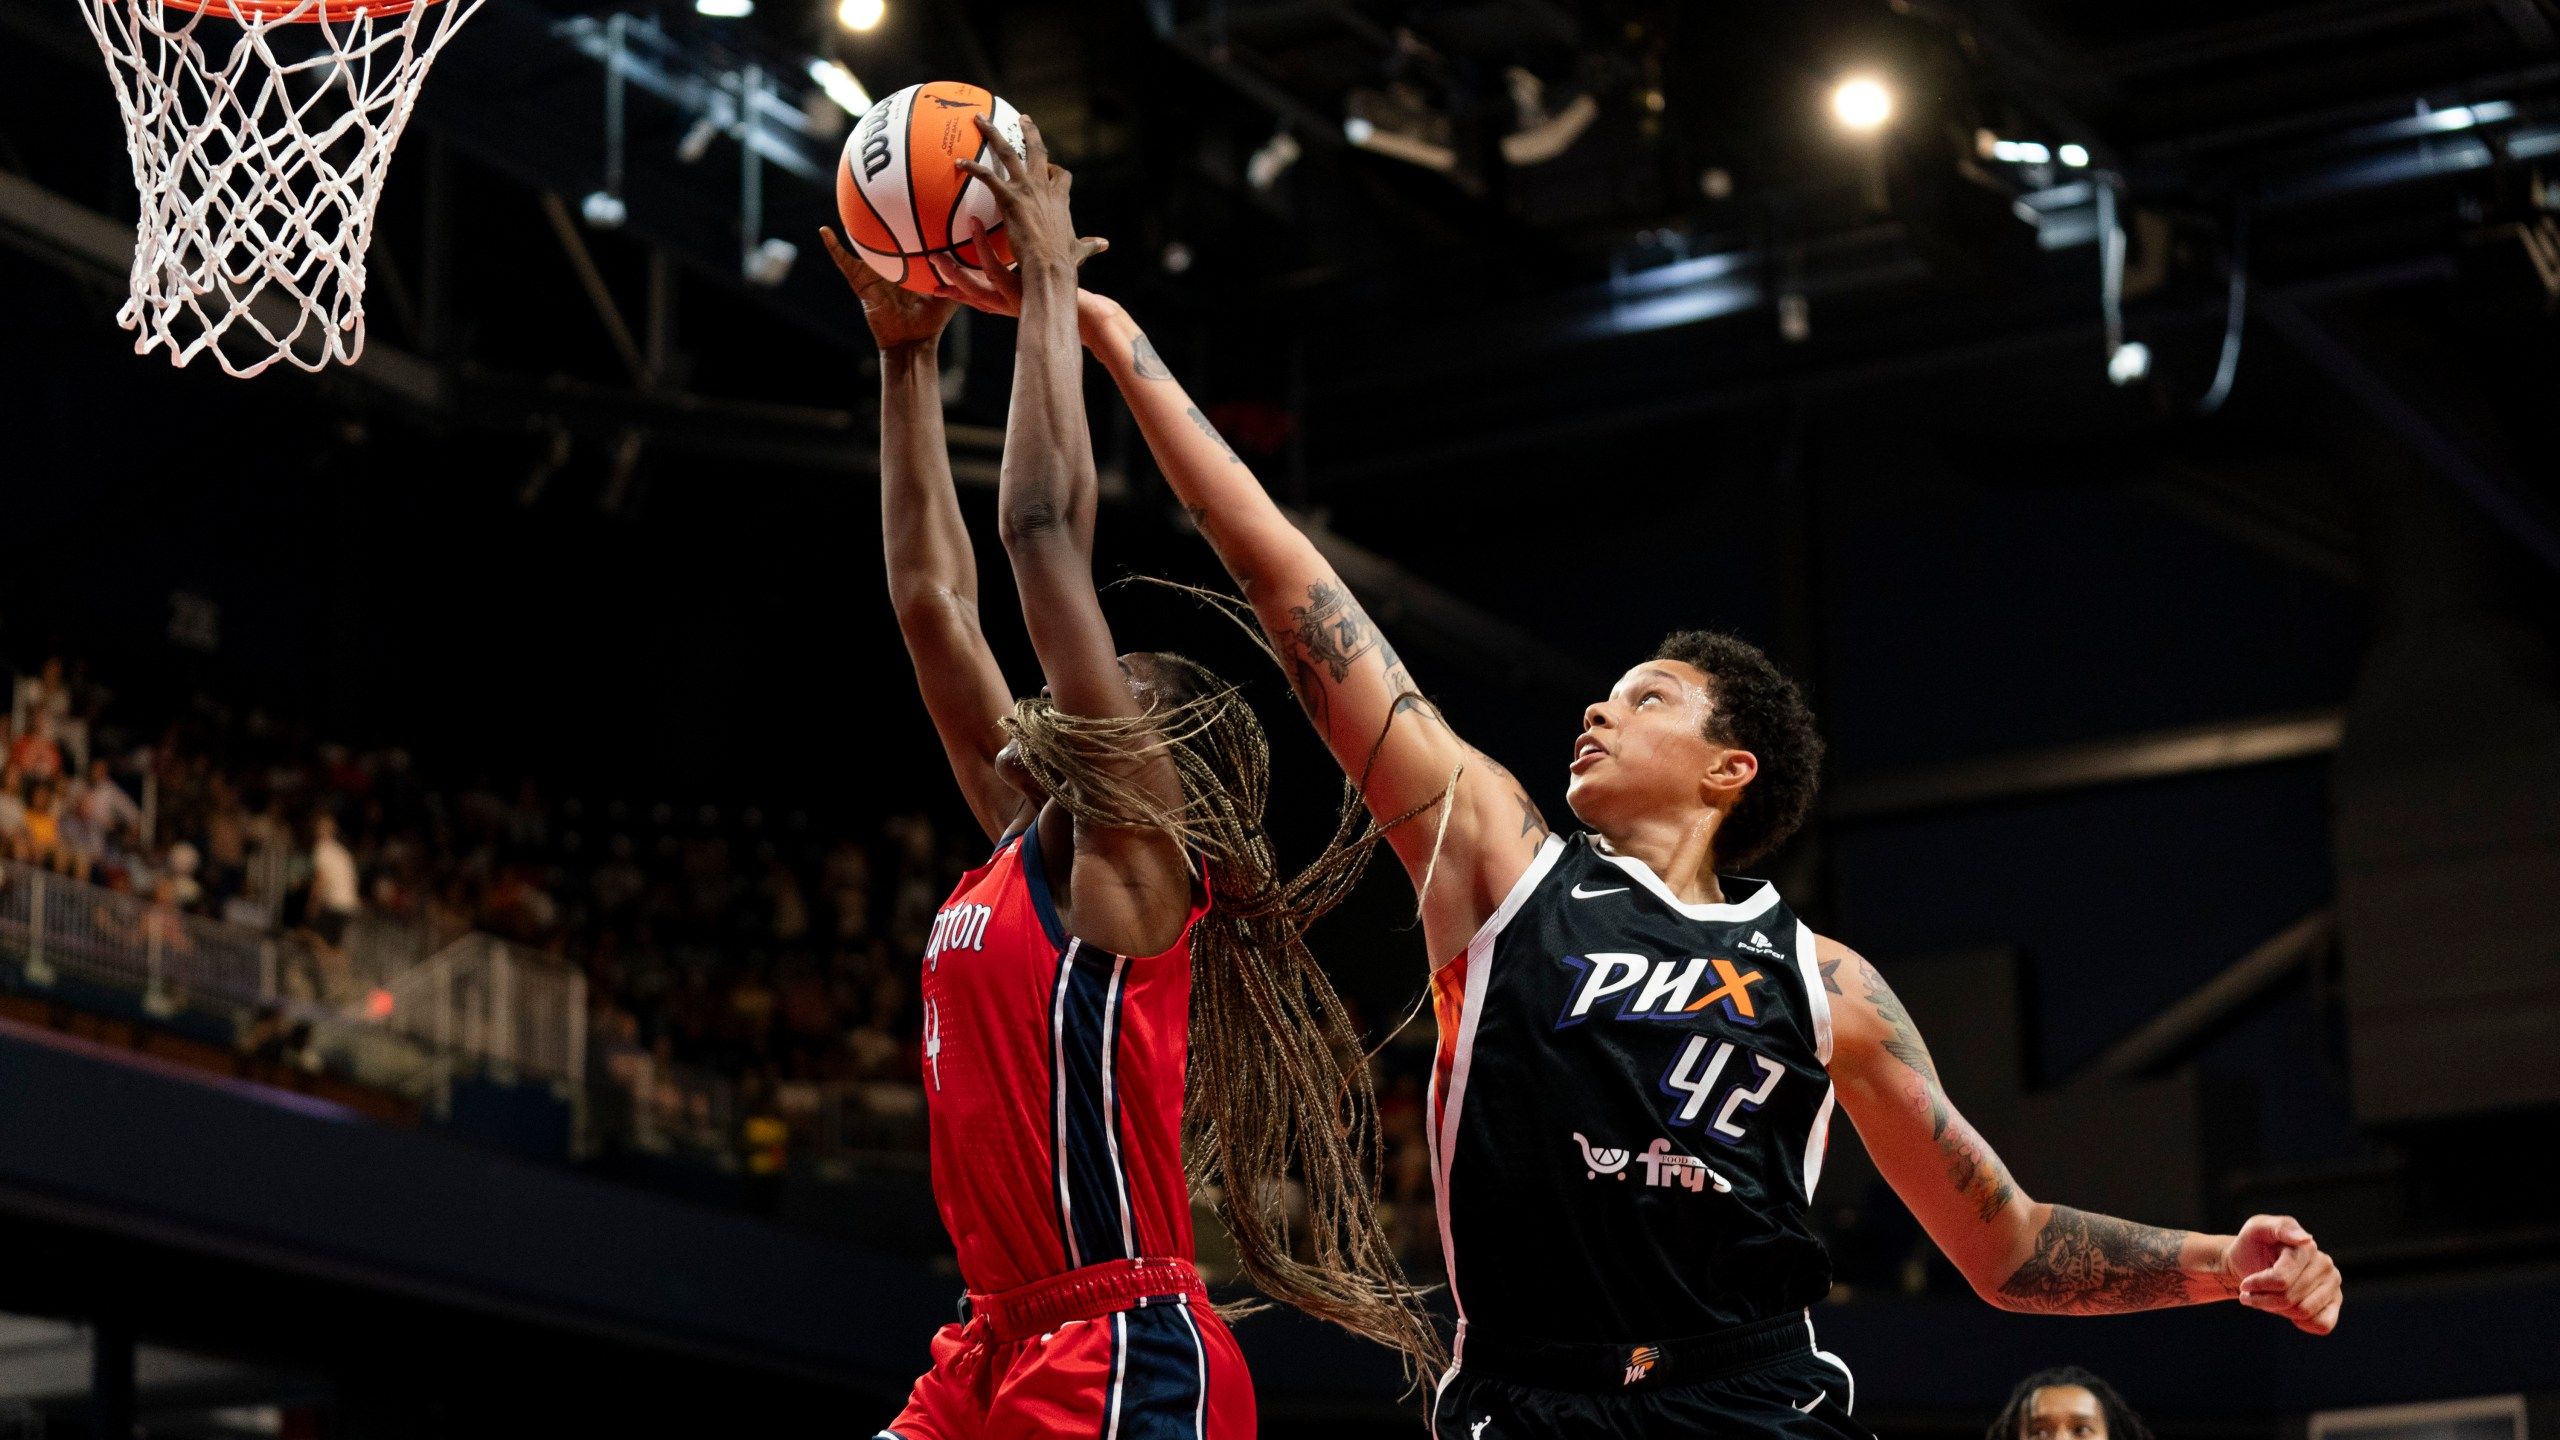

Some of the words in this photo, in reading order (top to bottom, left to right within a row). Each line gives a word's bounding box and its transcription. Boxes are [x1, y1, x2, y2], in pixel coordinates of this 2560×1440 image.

[1737, 941, 1785, 960] PayPal
[1554, 952, 1764, 1030] PHX
[1659, 1032, 1786, 1145] 42
[1662, 1155, 1689, 1165] FOOD
